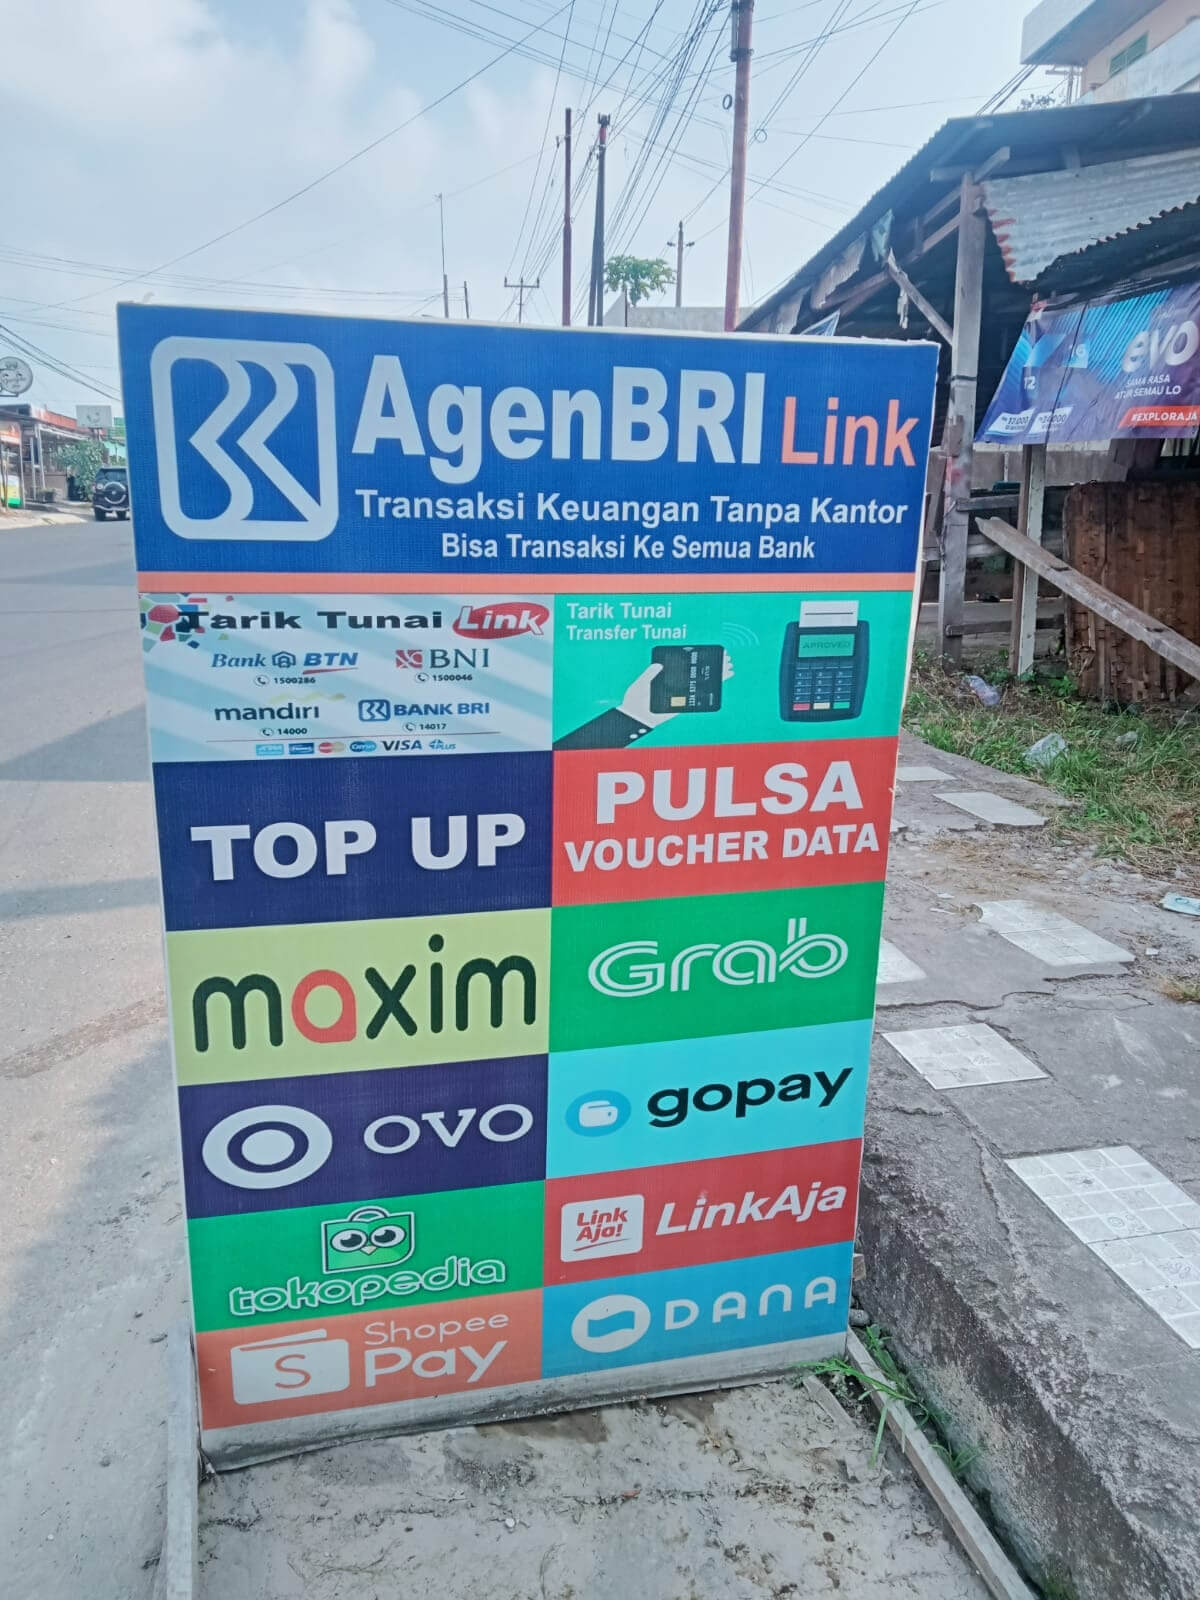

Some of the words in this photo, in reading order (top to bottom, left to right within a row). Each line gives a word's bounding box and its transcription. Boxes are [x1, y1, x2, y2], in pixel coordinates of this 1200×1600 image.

[1165, 385, 1182, 395] LO
[352, 354, 765, 484] AgenBRI
[781, 396, 919, 466] Link
[355, 489, 524, 520] Transaksi
[537, 492, 700, 529] Keuangan
[710, 496, 800, 529] Tanpa
[811, 497, 908, 524] Kantor
[442, 533, 498, 558] Bisa
[506, 534, 625, 559] Transaksi
[633, 535, 665, 558] Ke
[671, 535, 751, 559] Semua
[758, 535, 815, 559] Bank
[178, 611, 302, 629] Tarik
[317, 611, 442, 629] Tunai
[458, 605, 544, 635] Link
[567, 602, 614, 619] Tarik
[620, 602, 672, 619] Tunai
[566, 625, 638, 641] Transfer
[642, 624, 687, 639] Tunai
[211, 653, 267, 668] Bank
[303, 652, 359, 667] BTN
[429, 648, 490, 669] BNI
[274, 676, 316, 685] 1500286
[432, 674, 473, 682] 1500046
[214, 703, 320, 721] mandiri
[393, 703, 453, 716] BANK
[457, 702, 490, 715] BRI
[277, 727, 308, 736] 14000
[419, 722, 447, 731] 14017
[381, 740, 423, 751] VISA
[596, 761, 864, 825] PULSA
[190, 819, 377, 881] TOP
[411, 813, 526, 871] UP
[564, 830, 769, 872] VOUCHER
[782, 823, 880, 858] DATA
[588, 917, 849, 998] Grab
[192, 934, 537, 1053] maxim
[647, 1067, 854, 1128] gopay
[576, 1207, 628, 1227] Link
[655, 1181, 847, 1236] LinkAja
[229, 1255, 507, 1316] tokopedia
[664, 1276, 837, 1331] DANA
[364, 1313, 509, 1346] Shopee
[274, 1353, 311, 1389] S
[364, 1340, 508, 1388] Pay
